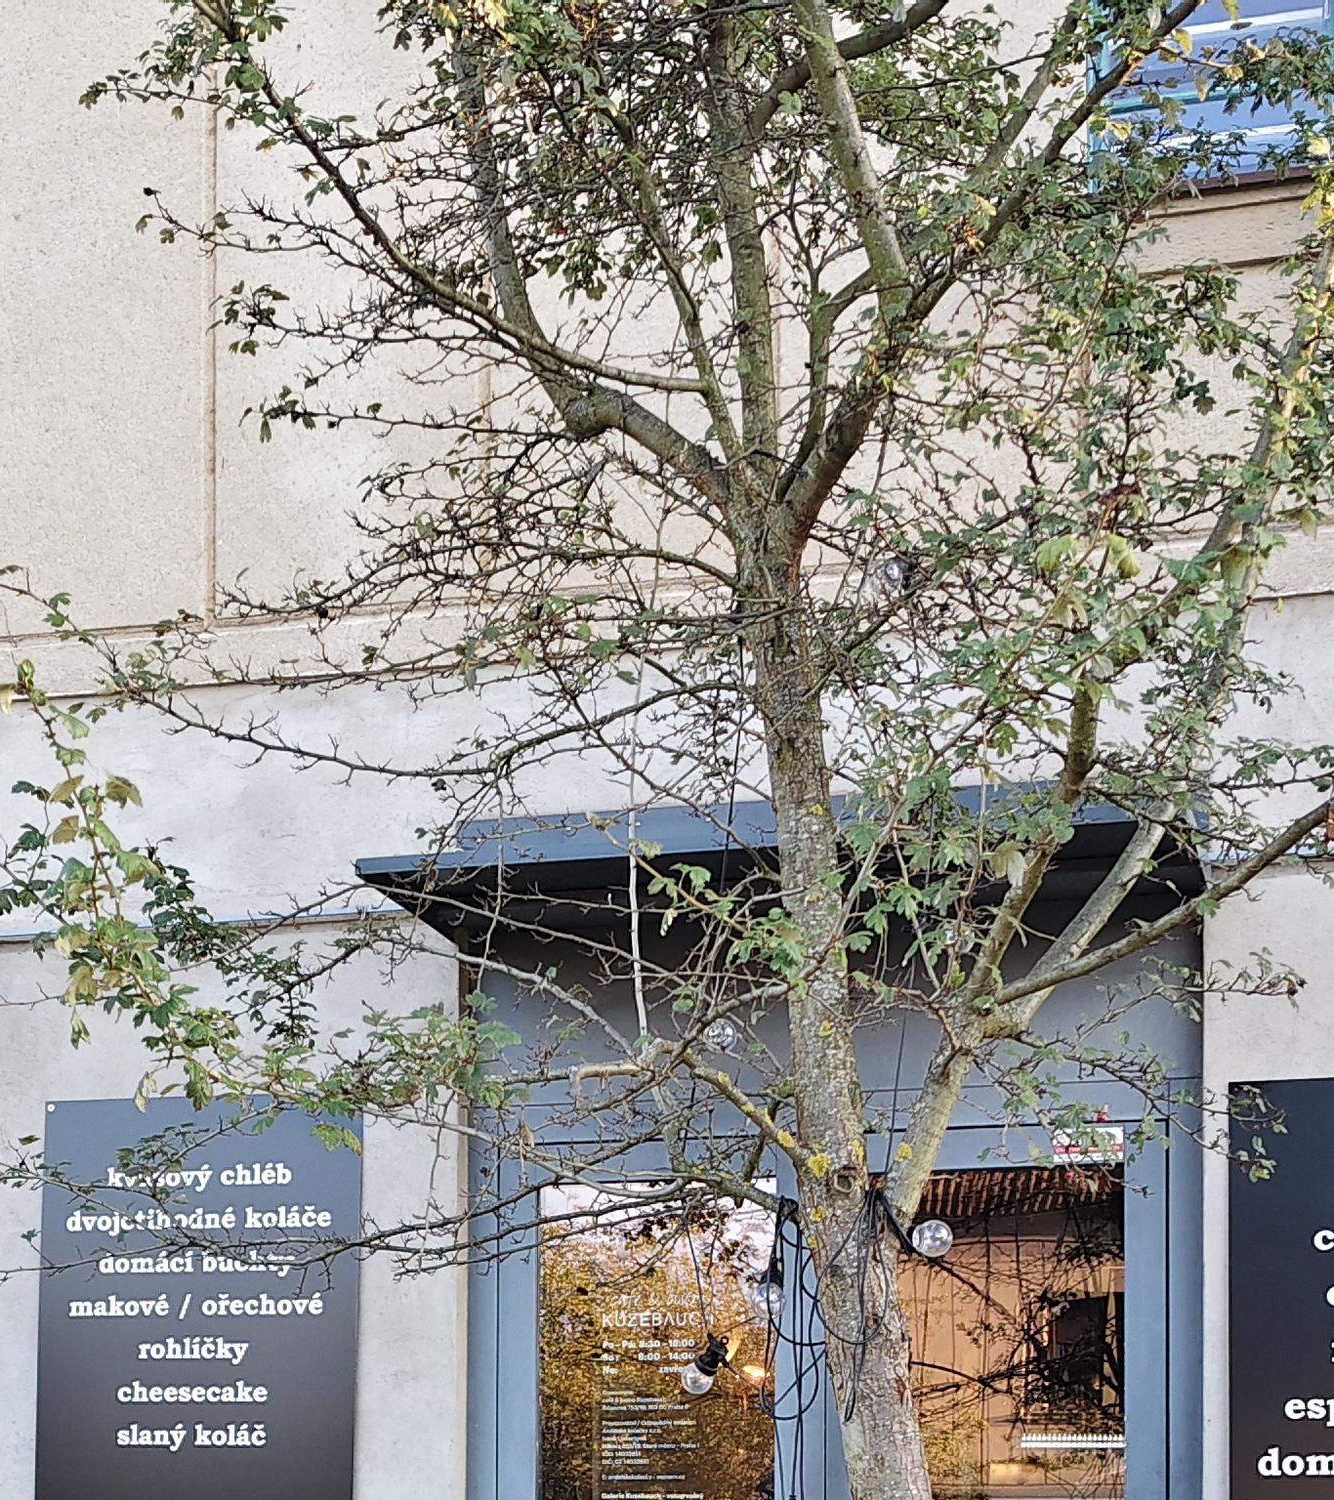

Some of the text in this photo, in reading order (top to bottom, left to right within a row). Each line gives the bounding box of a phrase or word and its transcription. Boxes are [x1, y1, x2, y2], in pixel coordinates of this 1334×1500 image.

[107, 1163, 291, 1193] kvsový chléb
[245, 1206, 331, 1229] koláče
[99, 1251, 194, 1274] domácí
[69, 1293, 323, 1319] makové / ořechové
[138, 1337, 249, 1365] rohlíčky
[117, 1381, 268, 1403] cheesecake
[117, 1424, 267, 1451] slaný koláč
